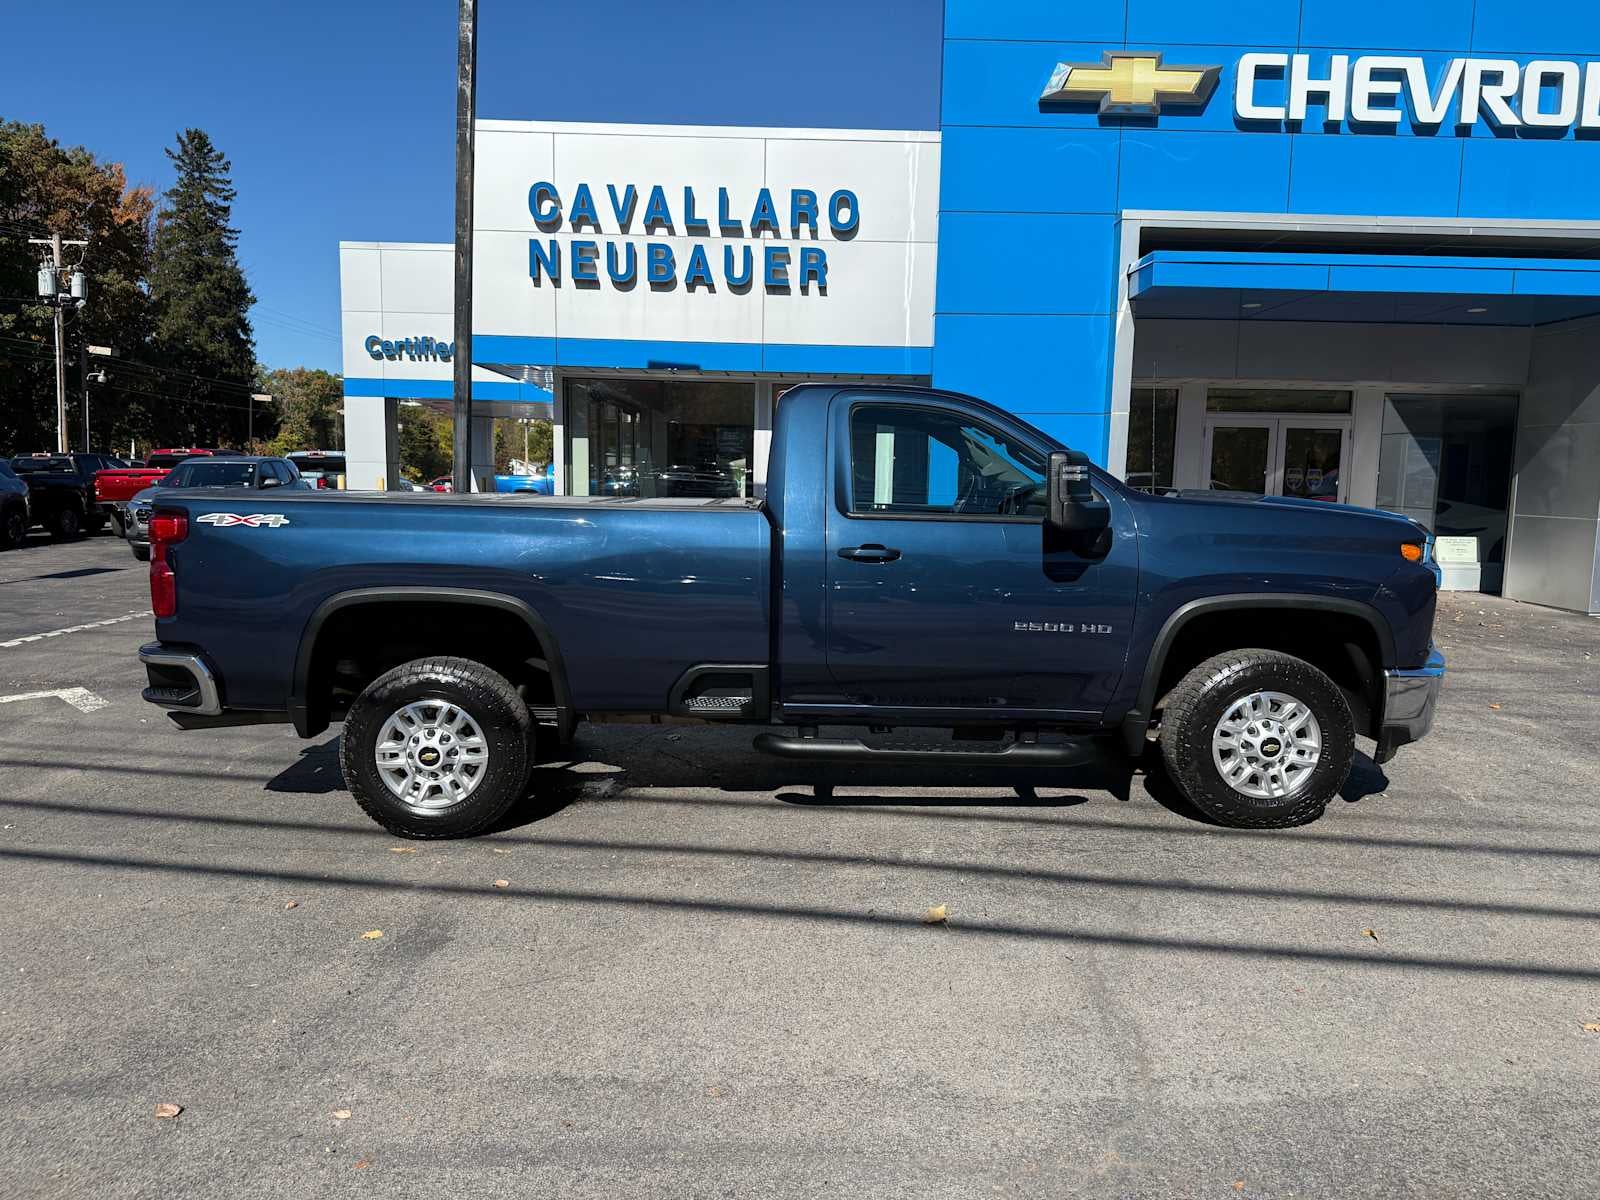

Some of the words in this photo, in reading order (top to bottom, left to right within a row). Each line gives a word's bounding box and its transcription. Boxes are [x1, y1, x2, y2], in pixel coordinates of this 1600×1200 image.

[528, 181, 860, 240] CAVALLARO
[528, 239, 828, 294] NEUBAUER
[1014, 621, 1074, 632] 2500
[1081, 623, 1113, 633] HD
